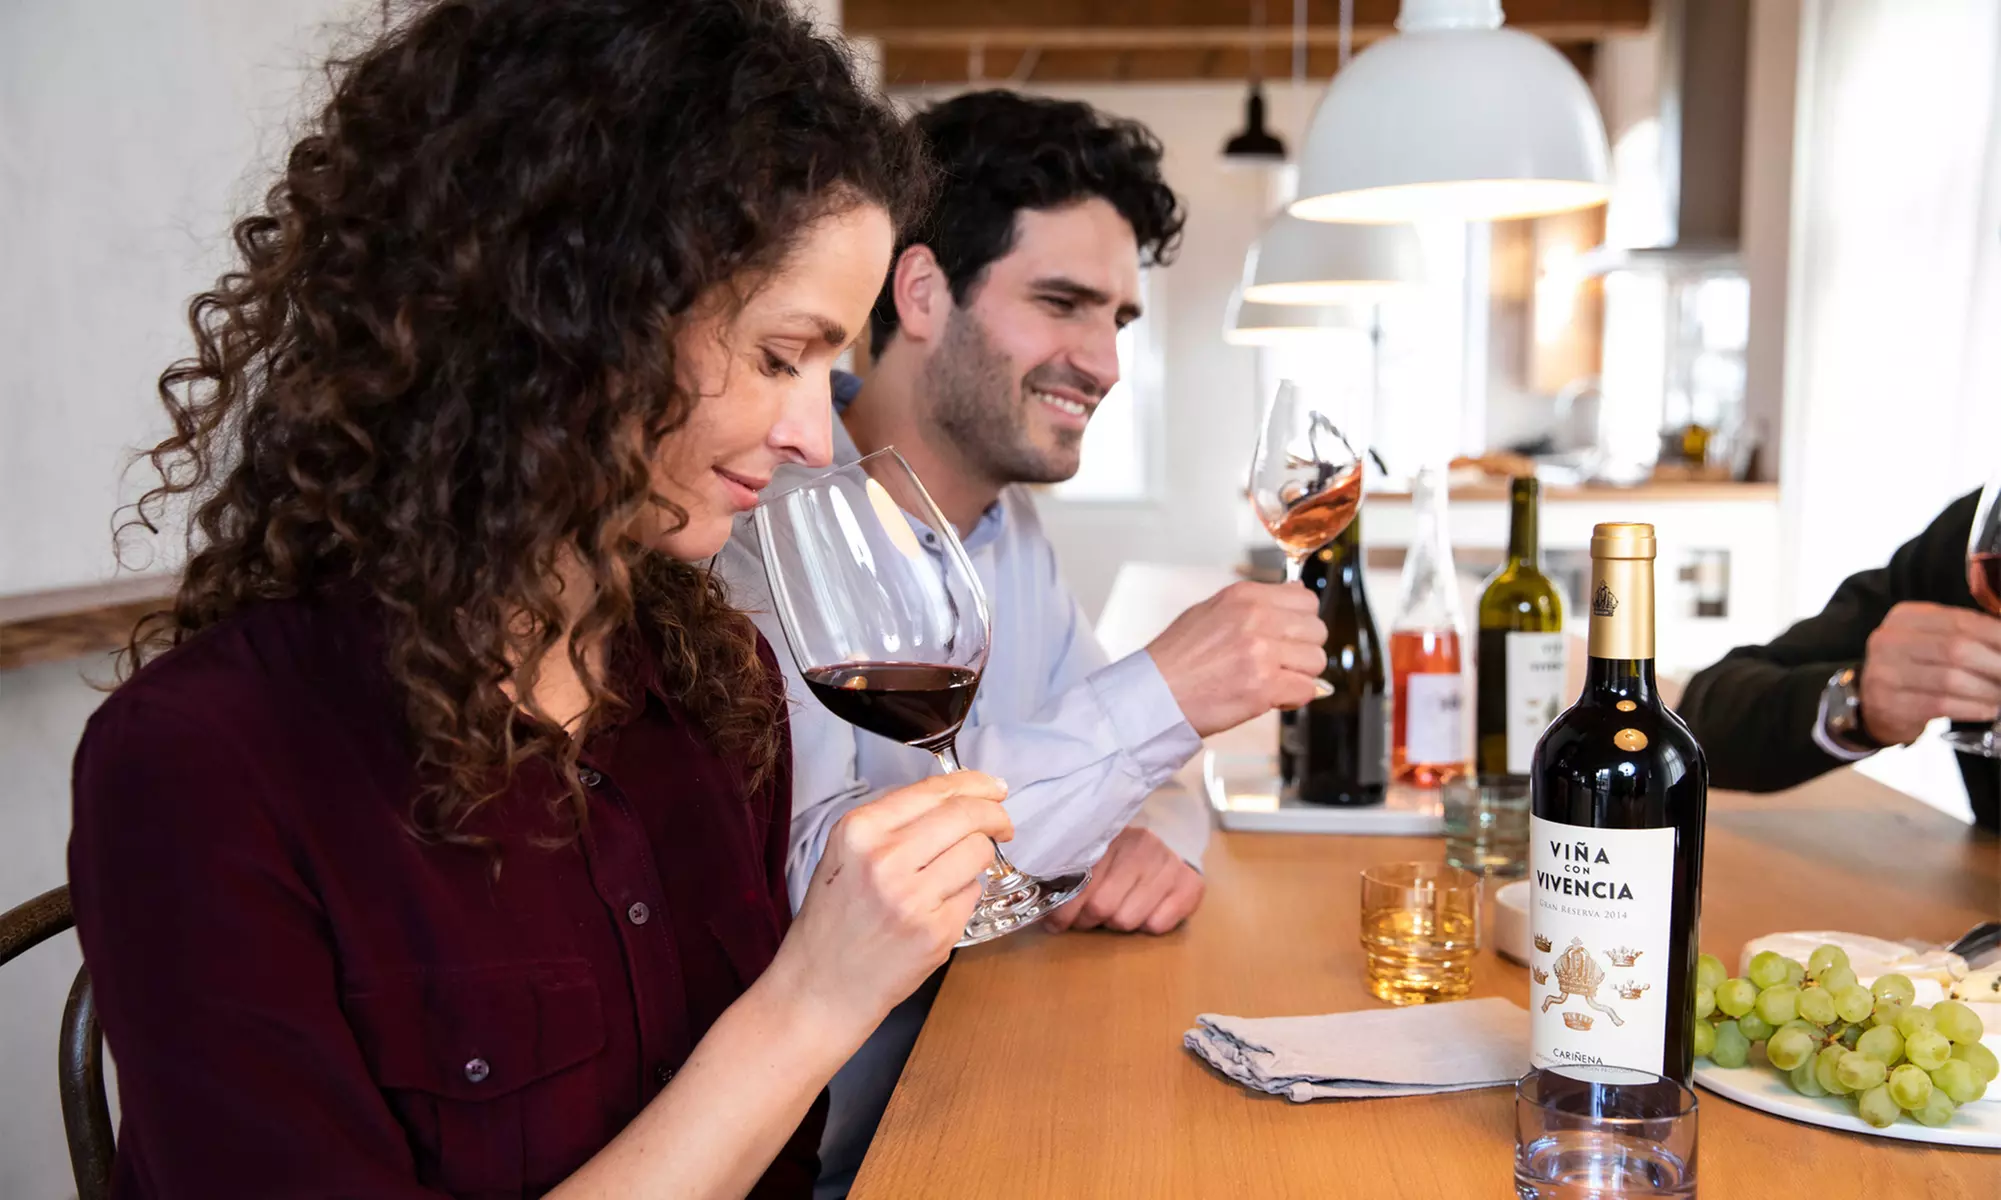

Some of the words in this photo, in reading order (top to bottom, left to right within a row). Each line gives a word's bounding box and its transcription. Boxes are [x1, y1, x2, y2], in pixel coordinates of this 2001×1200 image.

[1550, 841, 1610, 864] VIÑA
[1564, 864, 1590, 875] CON
[1537, 870, 1634, 900] VIVENCIA
[1604, 910, 1627, 919] 2014
[1553, 1048, 1603, 1065] CARIÑENA
